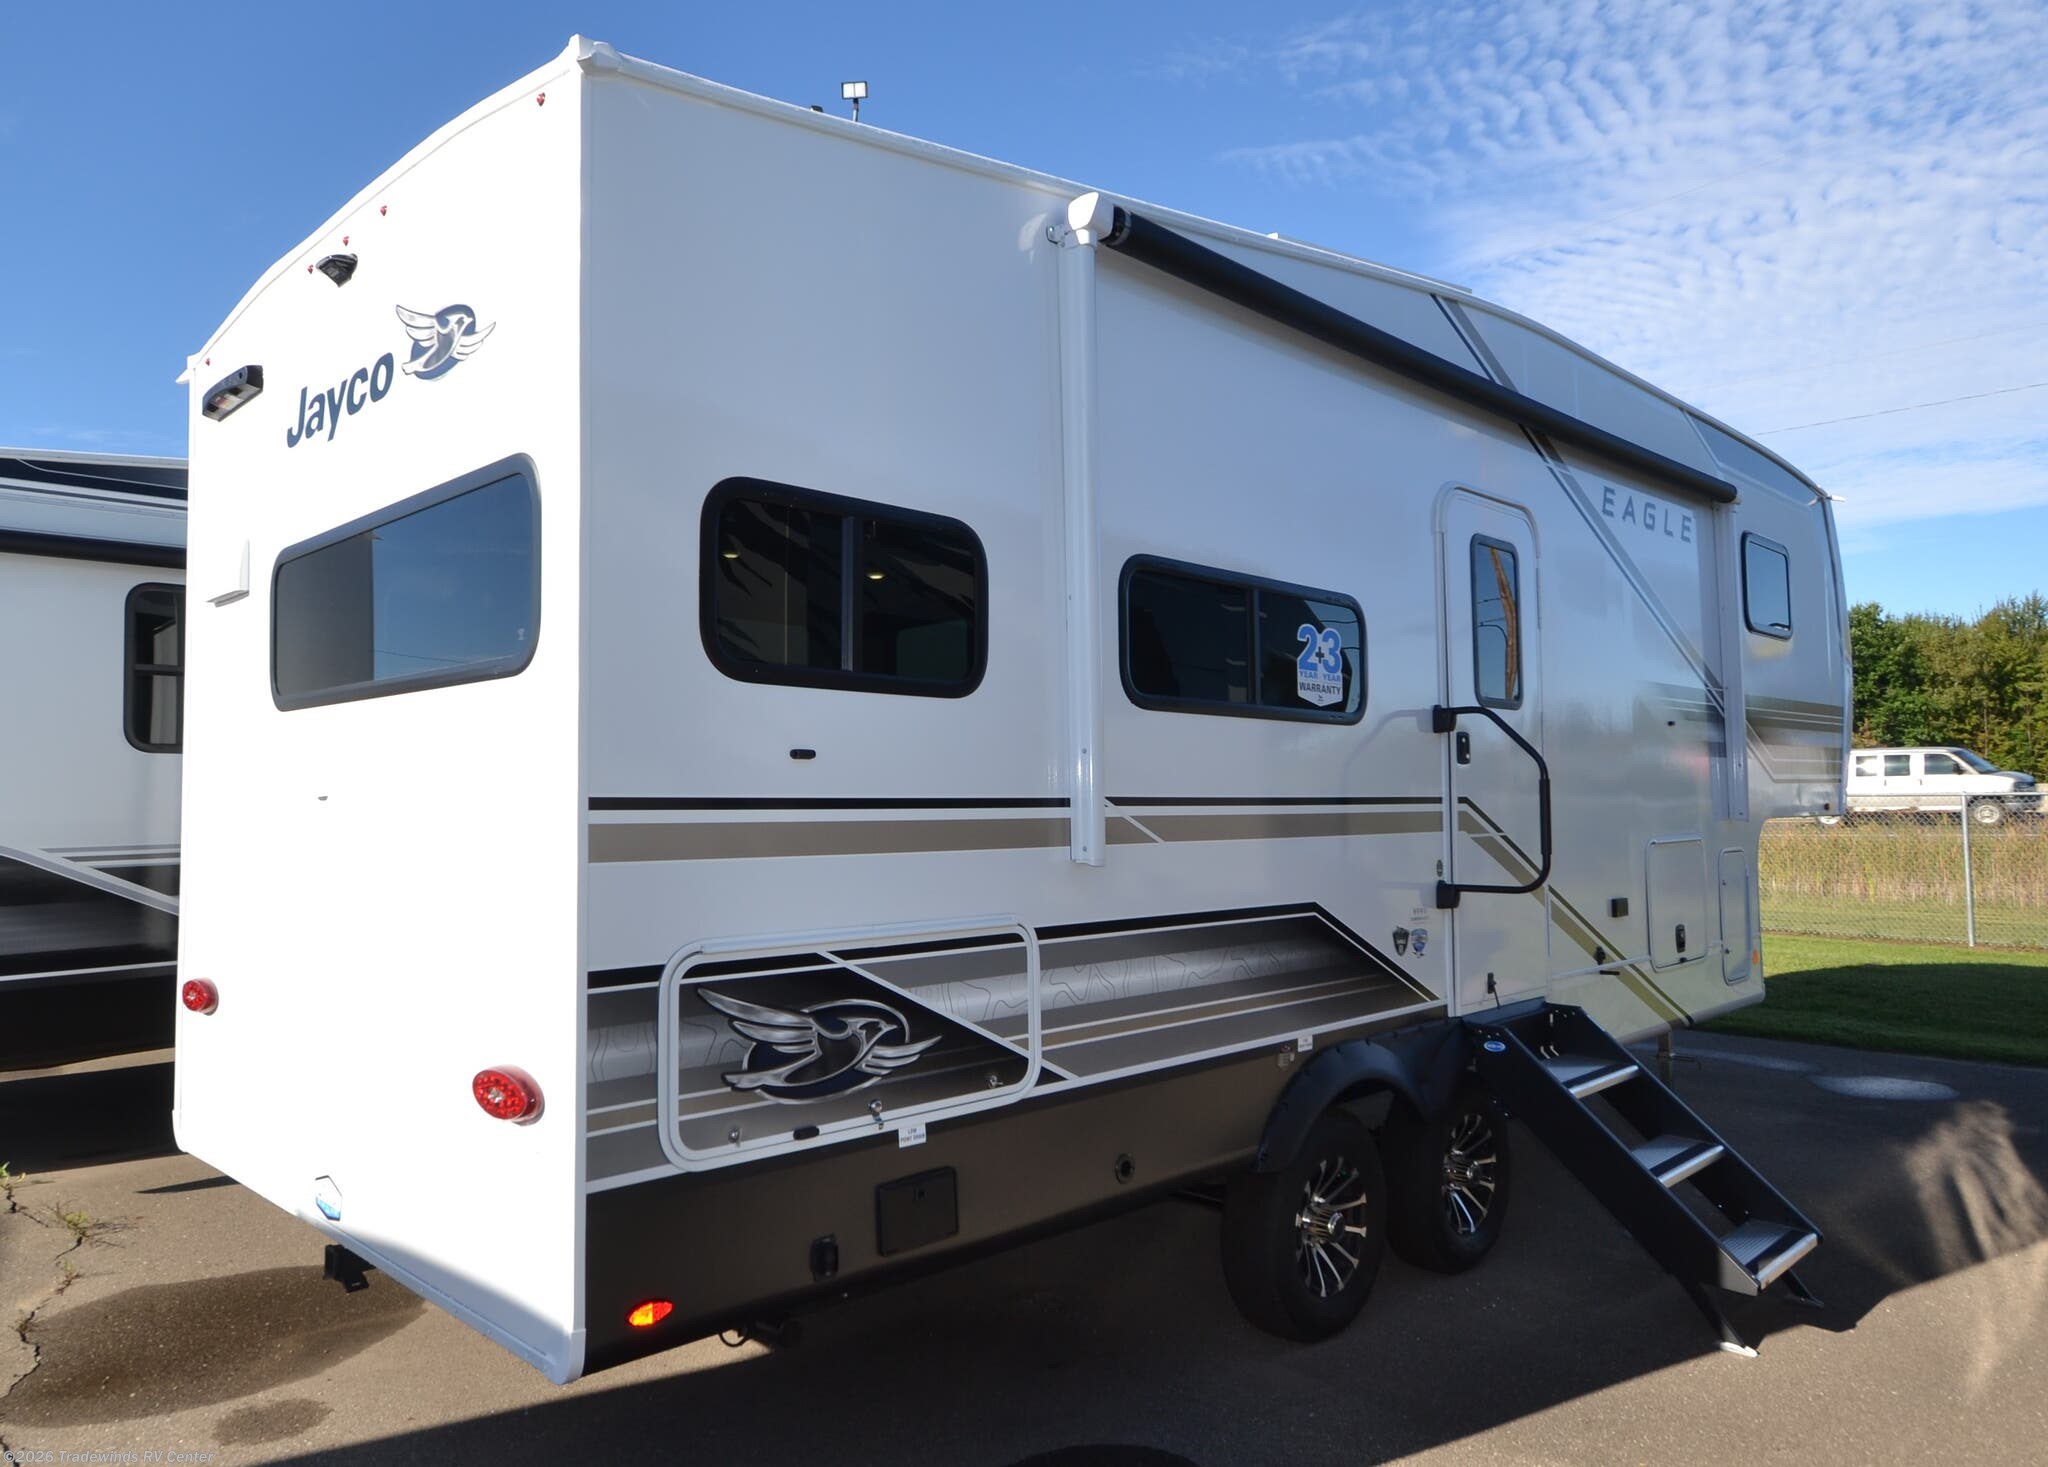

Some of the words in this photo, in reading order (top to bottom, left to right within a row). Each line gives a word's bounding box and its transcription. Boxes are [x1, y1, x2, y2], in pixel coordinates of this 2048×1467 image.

[287, 352, 394, 448] Jayco
[1602, 486, 1692, 543] EAGLE
[1299, 670, 1318, 680] YEAR
[1322, 673, 1341, 682] YEAR
[1299, 681, 1341, 695] WARRANTY
